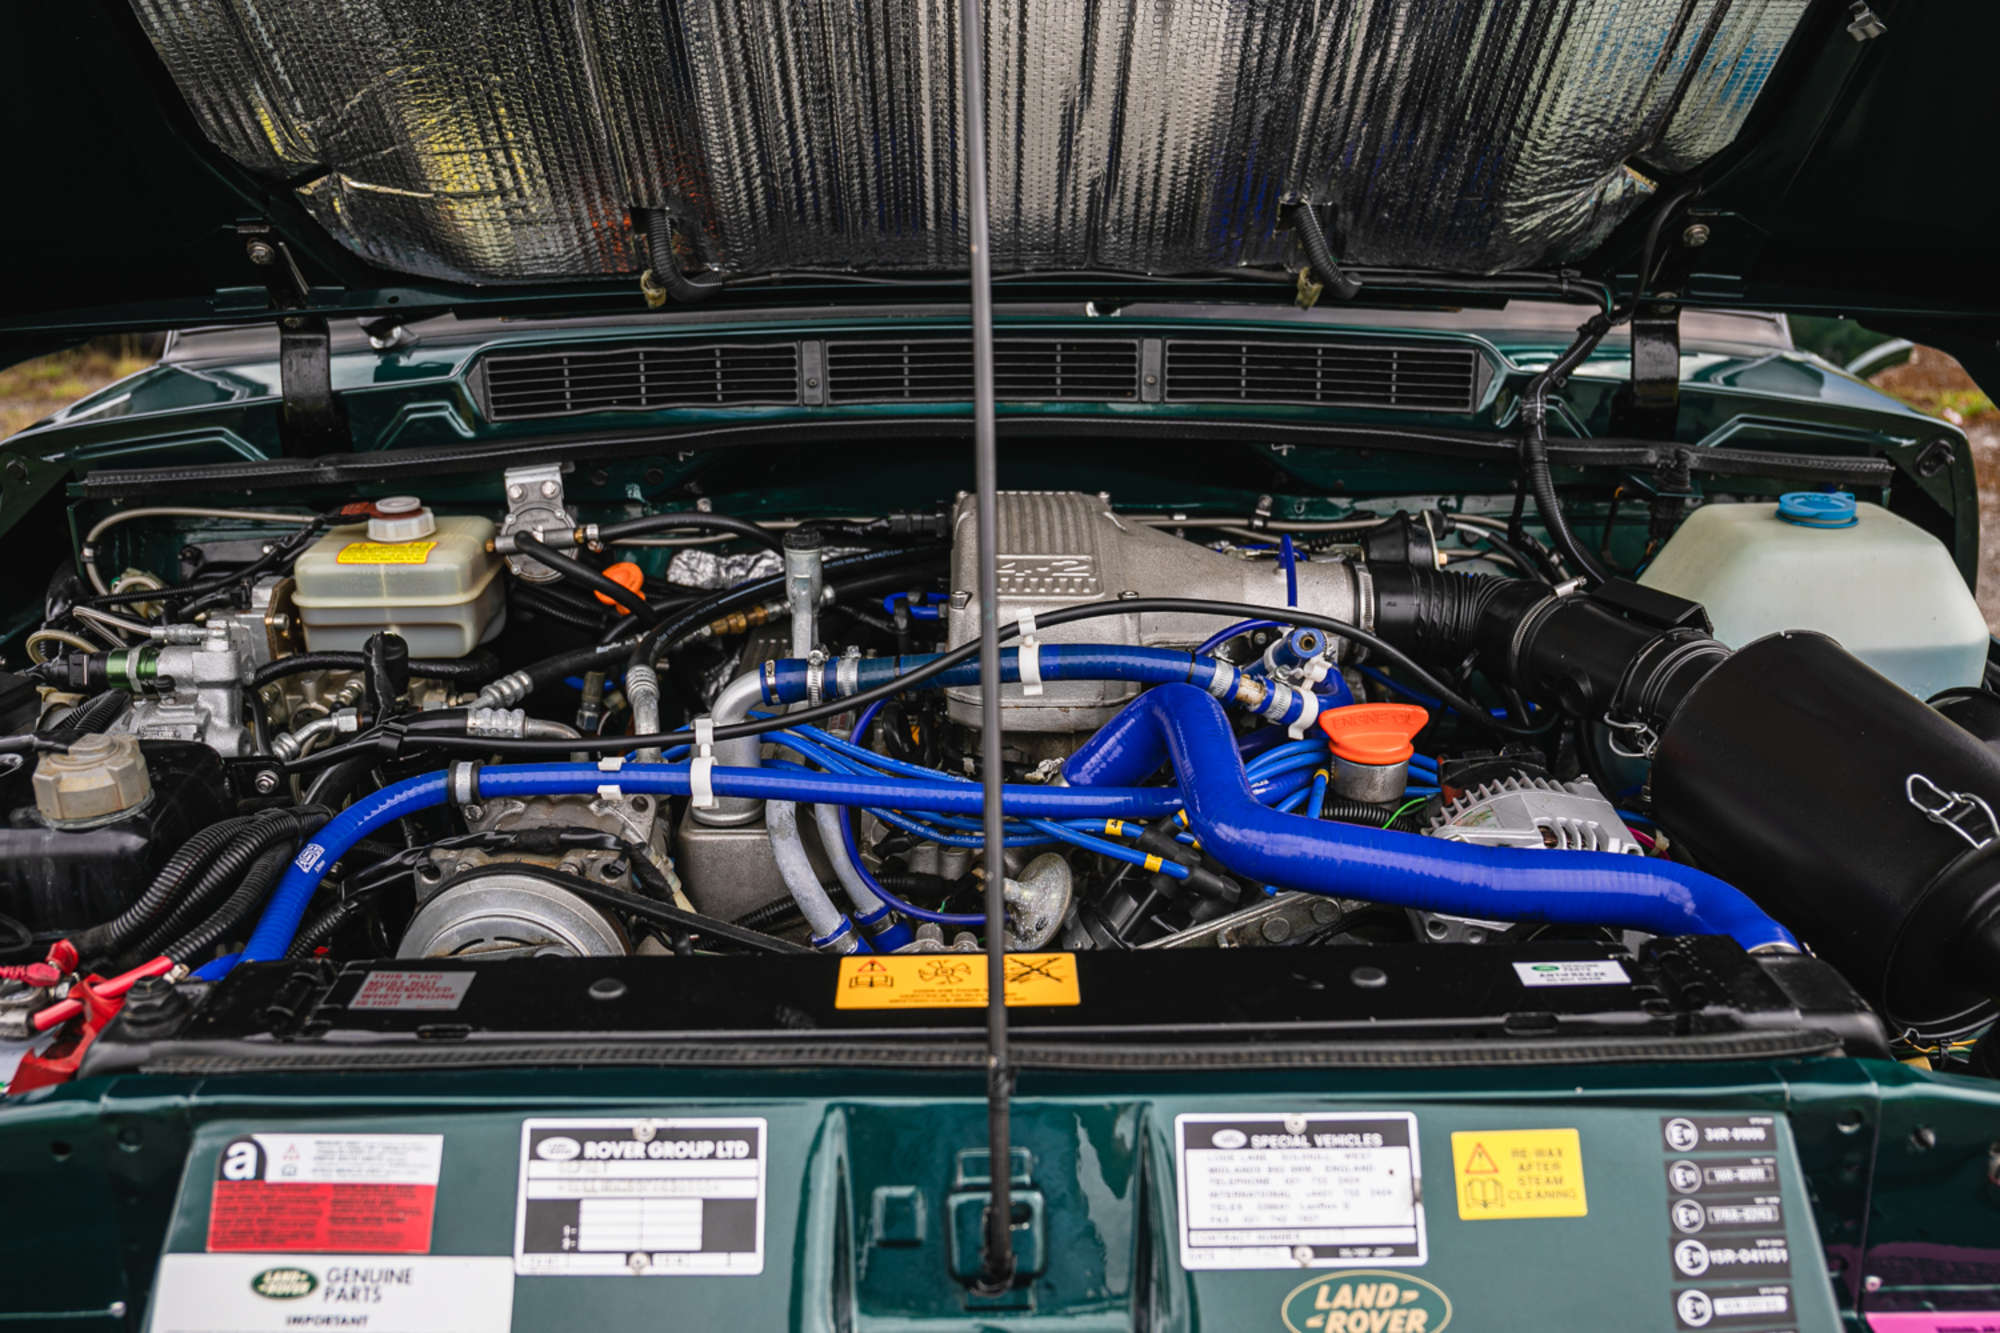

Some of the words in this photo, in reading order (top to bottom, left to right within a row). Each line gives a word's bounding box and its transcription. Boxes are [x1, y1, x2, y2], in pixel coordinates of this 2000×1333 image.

[1332, 713, 1387, 730] ENGINE
[1391, 712, 1415, 726] OIL
[1251, 1134, 1312, 1149] SPECIAL
[1314, 1132, 1383, 1148] VEHICLES
[584, 1141, 646, 1159] ROVER
[648, 1140, 714, 1158] GROUP
[715, 1139, 750, 1158] LTD
[1325, 1165, 1374, 1173] ENGLAND
[1518, 1162, 1561, 1171] AFTER
[1518, 1176, 1564, 1185] STEAM
[1209, 1191, 1291, 1199] INTERNATIONAL
[1507, 1189, 1577, 1200] CLEANING
[1257, 1233, 1301, 1241] NUMBER
[326, 1267, 414, 1286] GENUINE
[323, 1286, 383, 1304] PARTS
[1314, 1283, 1399, 1310] LAND
[285, 1315, 369, 1327] IMPORTANT
[1324, 1308, 1428, 1333] ROVER
